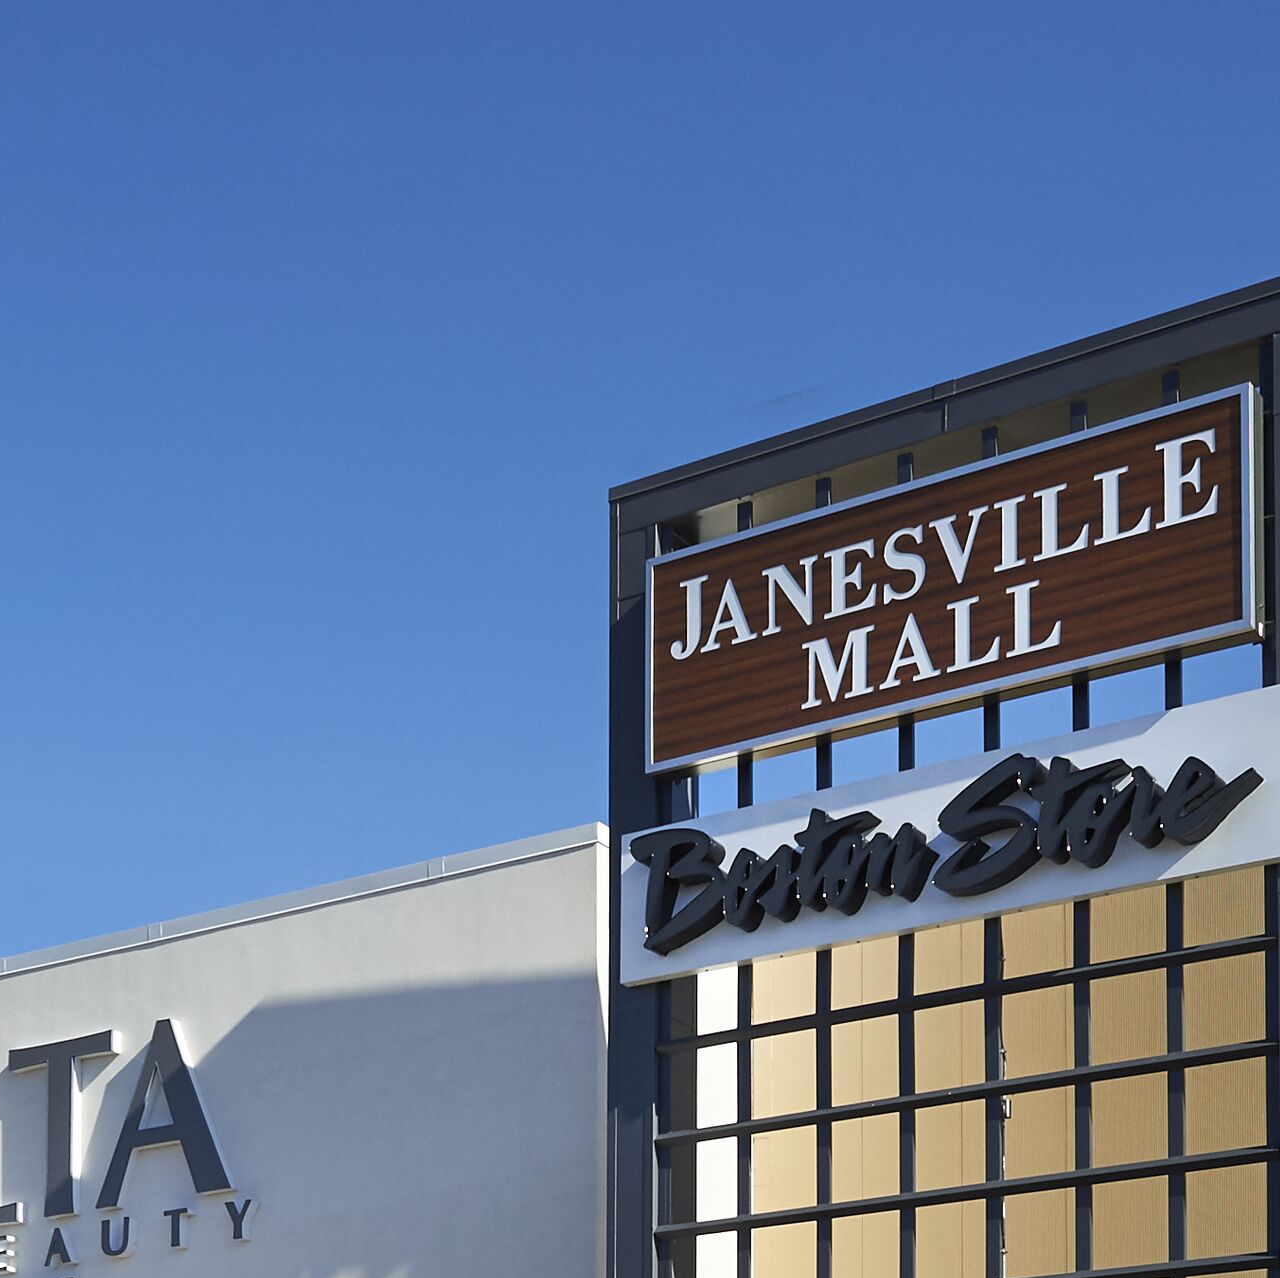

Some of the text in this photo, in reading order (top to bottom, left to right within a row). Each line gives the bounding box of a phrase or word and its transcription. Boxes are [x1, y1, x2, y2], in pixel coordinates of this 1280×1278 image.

[670, 427, 1221, 661] JANESVILLE
[800, 579, 1062, 711] MALL
[630, 752, 1265, 956] Boston Store
